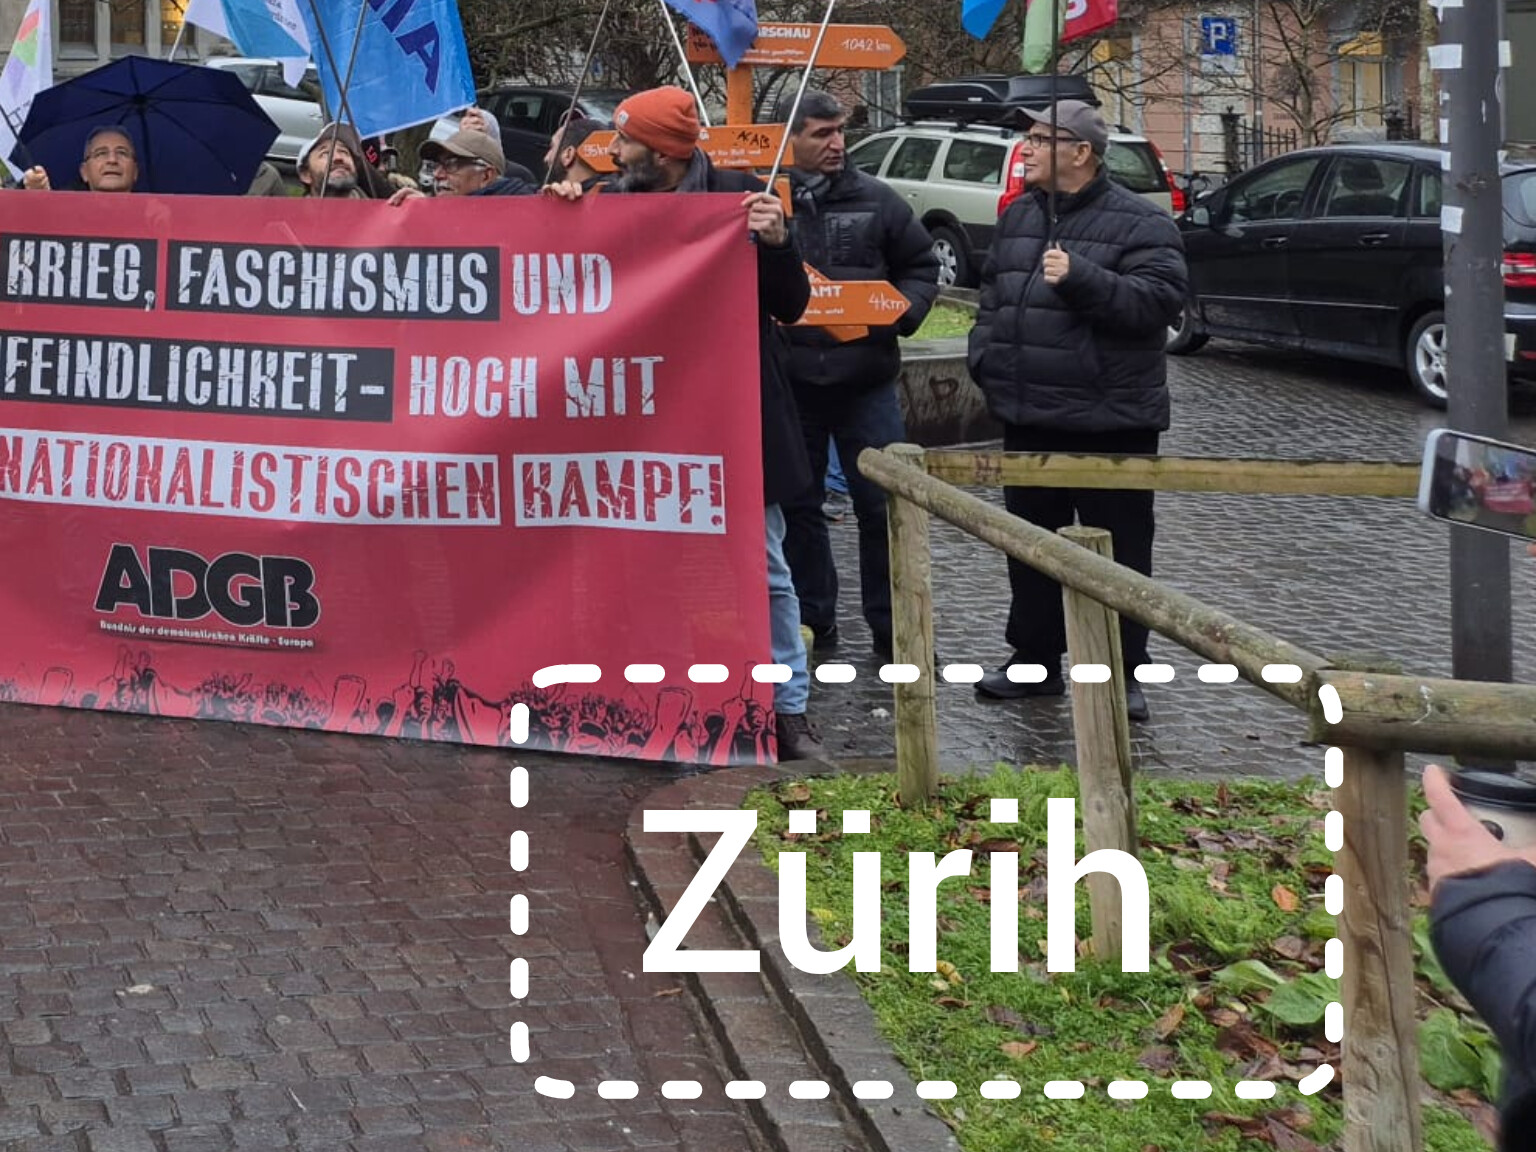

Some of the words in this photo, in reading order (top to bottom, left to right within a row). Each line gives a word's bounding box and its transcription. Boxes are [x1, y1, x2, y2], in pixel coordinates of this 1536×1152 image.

[757, 25, 811, 39] ARSCHAU
[6, 238, 157, 312] KRIEG,
[177, 246, 489, 315] FASCHISMUS
[512, 253, 613, 315] UND
[408, 355, 538, 419] HOCH
[564, 355, 665, 418] MIT
[522, 460, 724, 527] KAMPF!
[95, 544, 321, 628] ADGB
[278, 636, 314, 649] Europa
